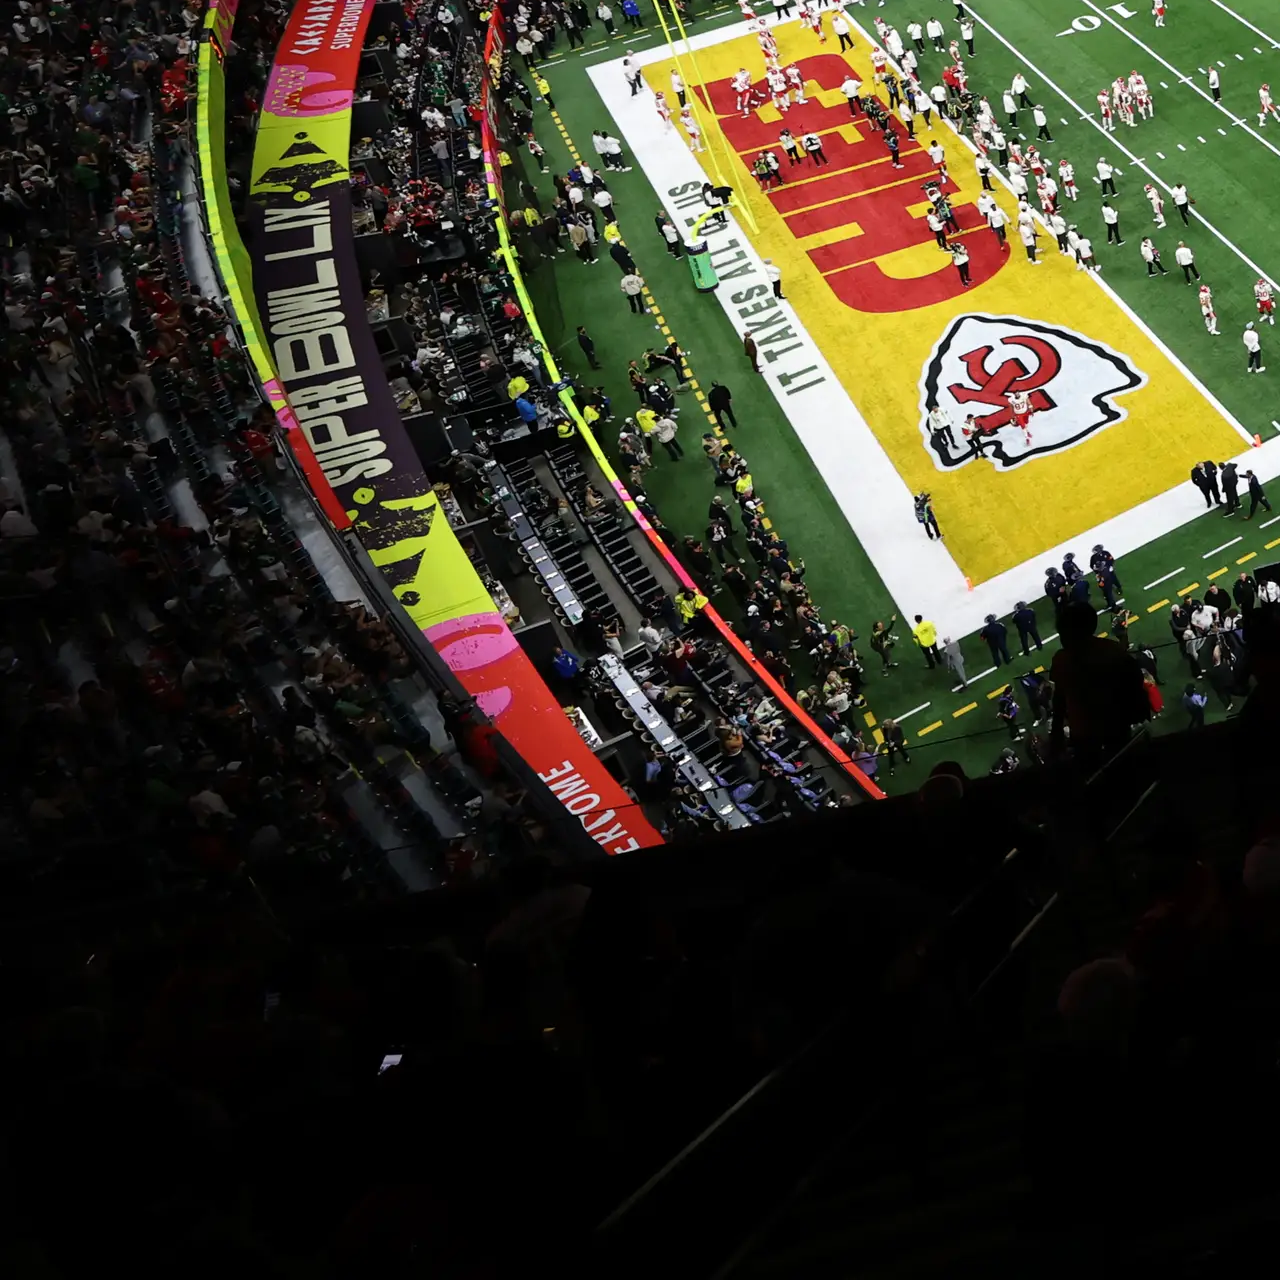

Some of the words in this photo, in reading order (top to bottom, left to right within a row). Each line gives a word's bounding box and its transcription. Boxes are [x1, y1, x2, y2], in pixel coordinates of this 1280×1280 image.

[1072, 3, 1137, 31] 10
[668, 180, 704, 210] US
[692, 53, 1011, 313] CHIEFS
[264, 200, 333, 262] LIX
[710, 238, 757, 282] ALL
[267, 257, 357, 382] BOWL
[730, 283, 804, 364] TAKES
[776, 364, 826, 396] IT
[947, 335, 1062, 436] KC
[287, 375, 394, 488] SUPER
